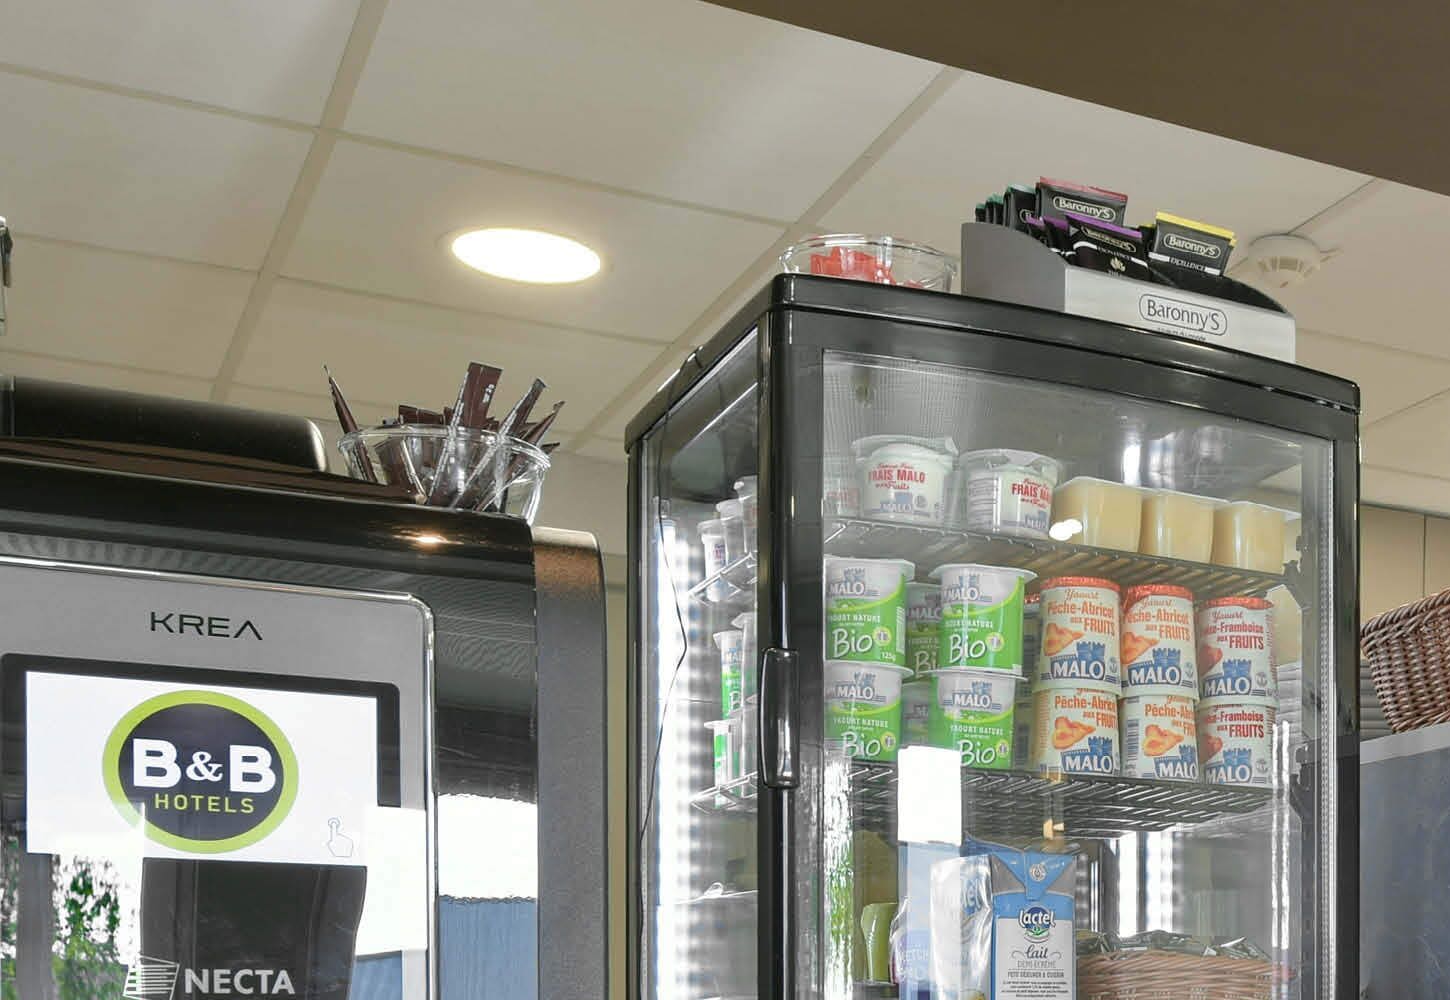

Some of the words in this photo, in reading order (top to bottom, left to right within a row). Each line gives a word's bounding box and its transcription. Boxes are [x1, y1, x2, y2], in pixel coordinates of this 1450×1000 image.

[1146, 299, 1220, 331] Baronny'S
[1012, 483, 1038, 498] FRAIS
[150, 611, 264, 641] KREA
[1084, 617, 1115, 637] FRUITS
[1159, 624, 1191, 641] FRUITS
[832, 628, 873, 658] Bio
[950, 633, 986, 664] Bio
[1229, 635, 1265, 650] FRUITS
[1052, 660, 1105, 679] MALO
[1130, 666, 1182, 686] MALO
[837, 686, 874, 700] MALO
[1204, 677, 1251, 697] MALO
[953, 694, 992, 708] MALO
[1229, 724, 1265, 739] FRUITS
[841, 730, 881, 759] Bio
[957, 739, 996, 767] Bio
[132, 738, 277, 794] B&B
[1064, 755, 1113, 774] MALO
[1205, 764, 1251, 785] MALO
[154, 793, 255, 814] HOTELS
[1018, 909, 1056, 929] lactel
[184, 968, 296, 995] NECTA
